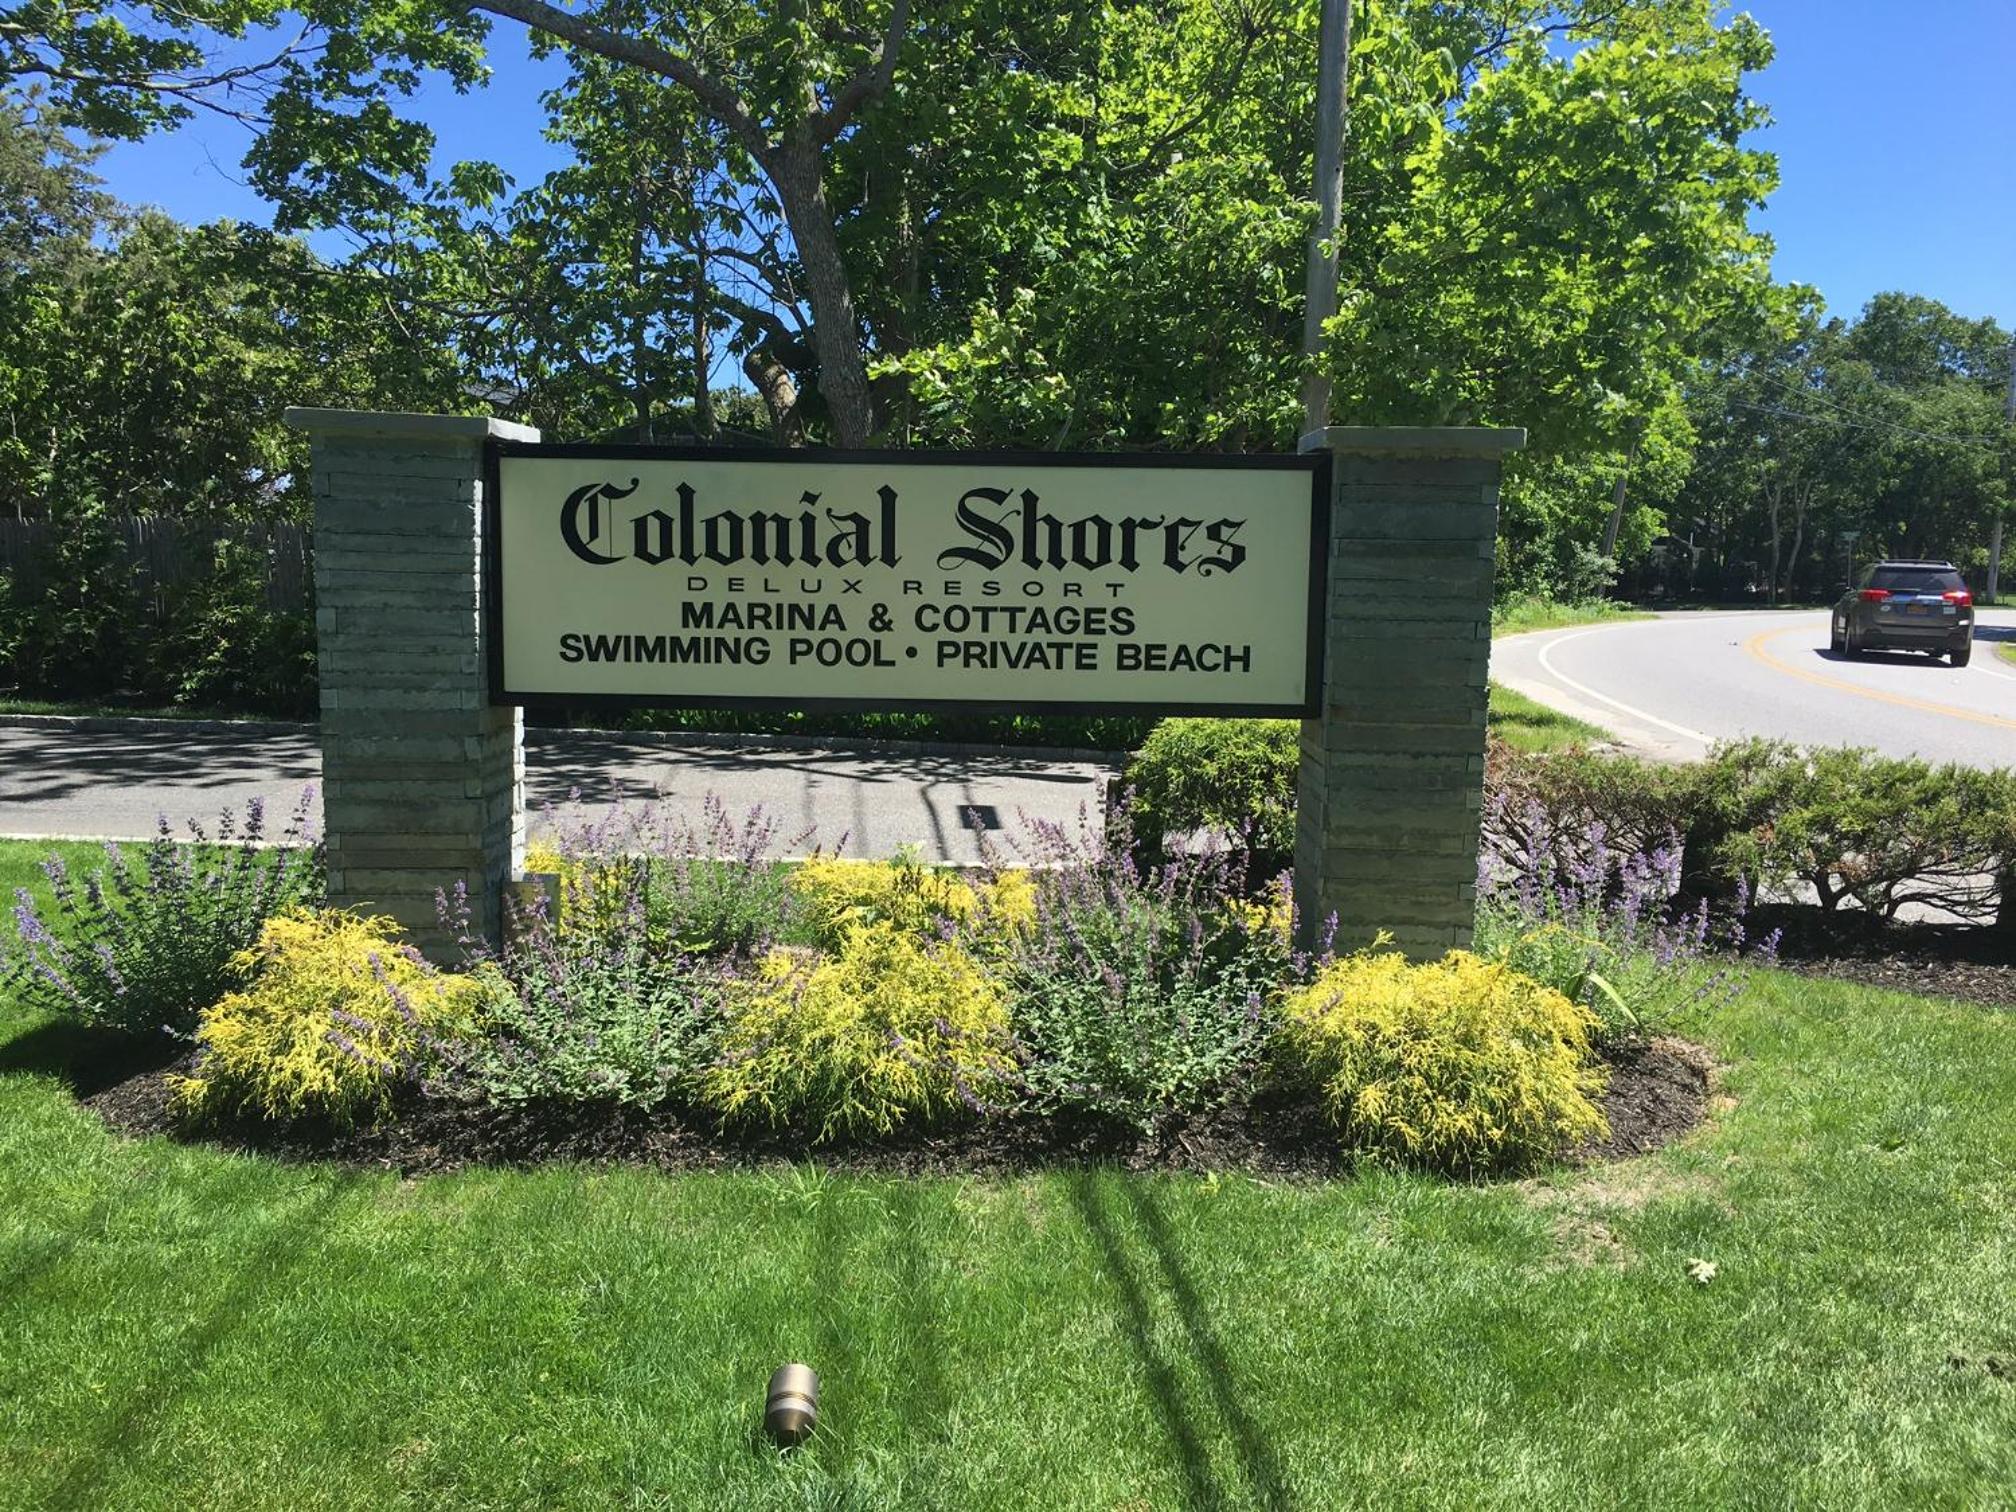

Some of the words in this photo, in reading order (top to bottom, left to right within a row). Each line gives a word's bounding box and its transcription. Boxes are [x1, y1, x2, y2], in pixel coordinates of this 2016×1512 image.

[559, 476, 903, 570] Colonial
[936, 486, 1249, 578] Shores
[687, 575, 863, 595] DELUX
[902, 579, 1126, 599] RESORT
[681, 600, 848, 632] MARINA
[867, 602, 895, 634] &
[914, 602, 1136, 637] COTTAGES
[558, 632, 771, 666] SWIMMING
[789, 637, 897, 668] POOL
[936, 639, 1099, 671] PRIVATE
[1116, 642, 1251, 674] BEACH
